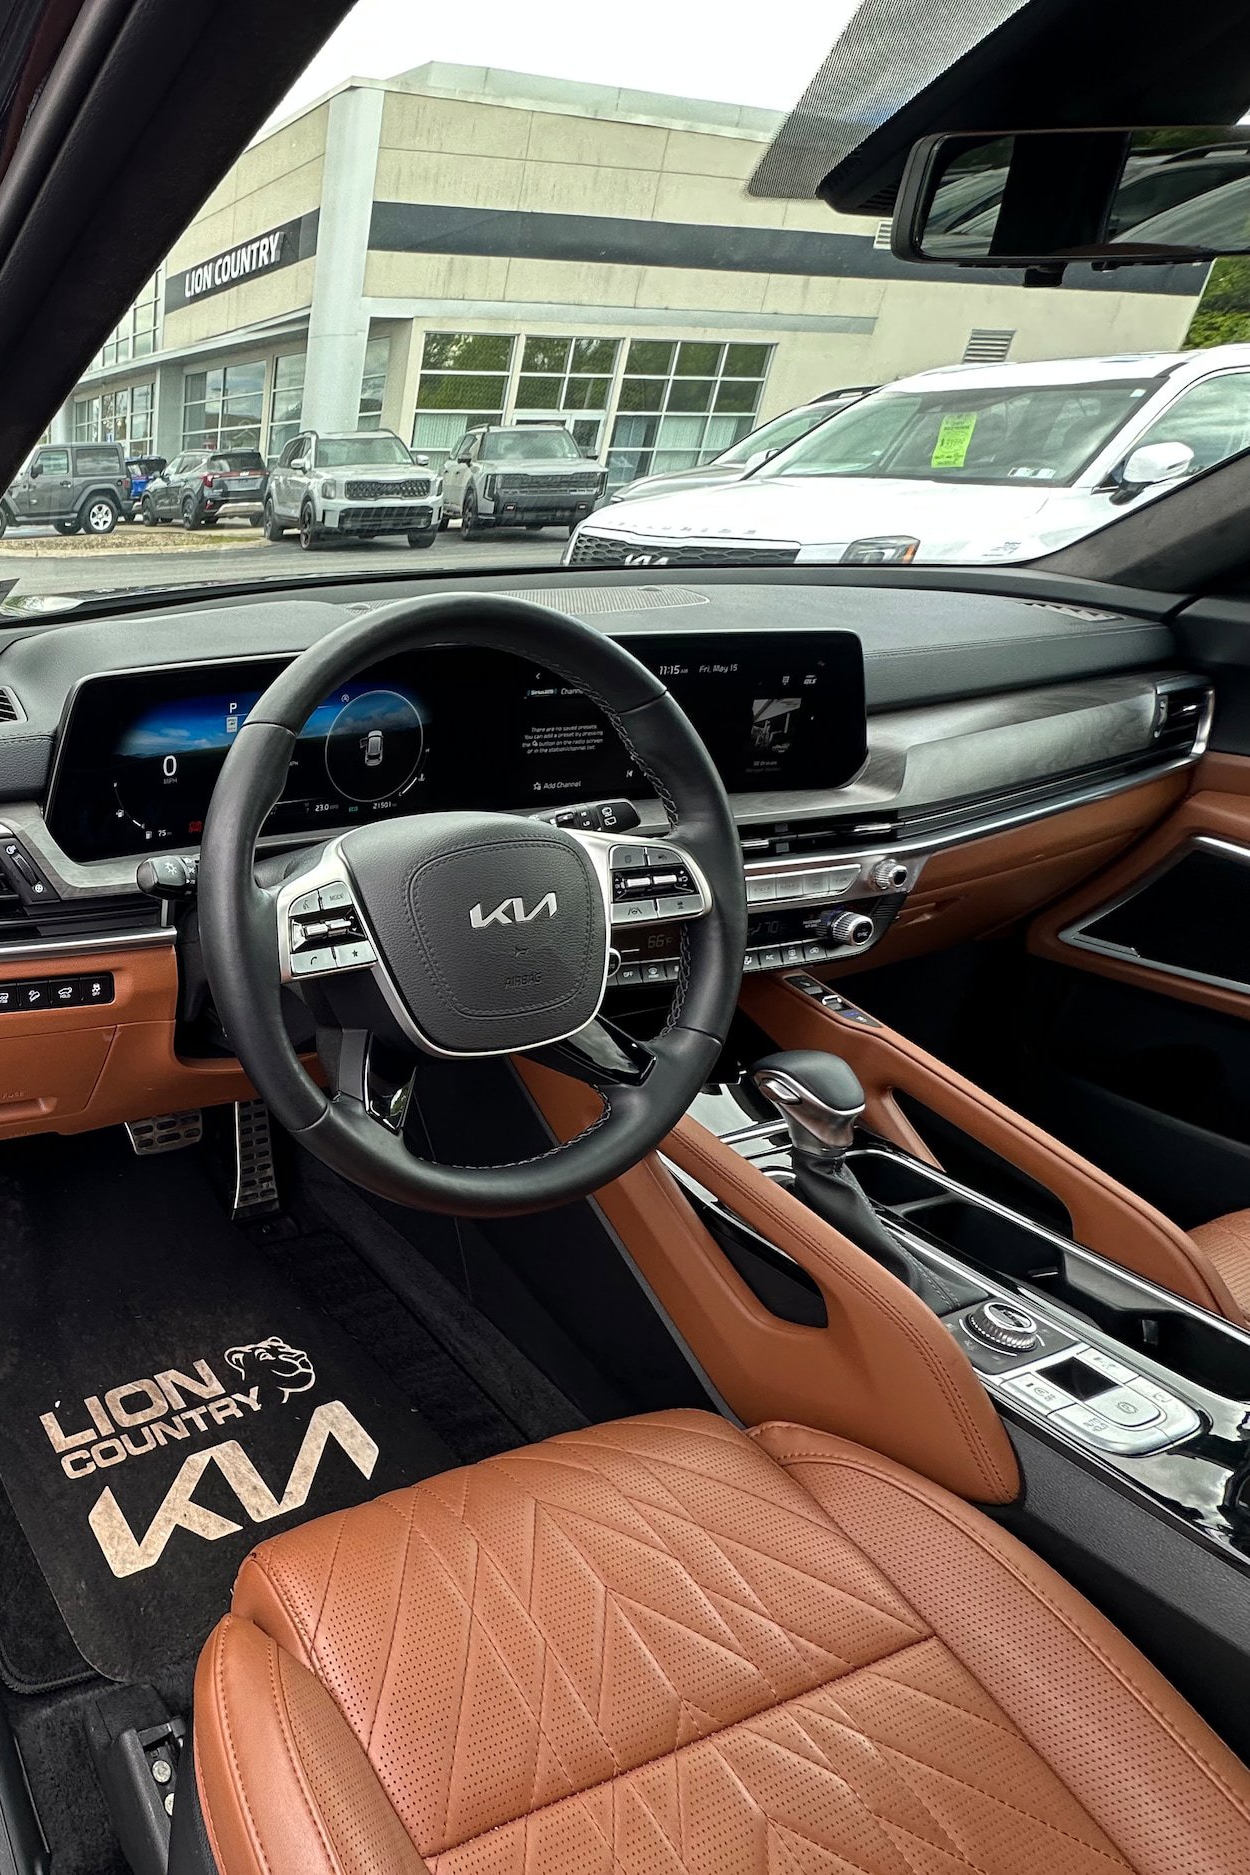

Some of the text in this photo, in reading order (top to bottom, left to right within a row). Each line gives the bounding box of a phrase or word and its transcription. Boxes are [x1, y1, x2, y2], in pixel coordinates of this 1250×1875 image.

[185, 231, 283, 298] LION COUNTRY
[659, 665, 680, 675] 11:15
[713, 665, 729, 674] May
[229, 702, 237, 713] P
[163, 755, 177, 776] 0
[315, 804, 329, 812] 23.0
[469, 892, 558, 929] KIA
[39, 1359, 226, 1454] LION
[60, 1386, 262, 1480] COUNTRY
[88, 1400, 380, 1579] KIA
